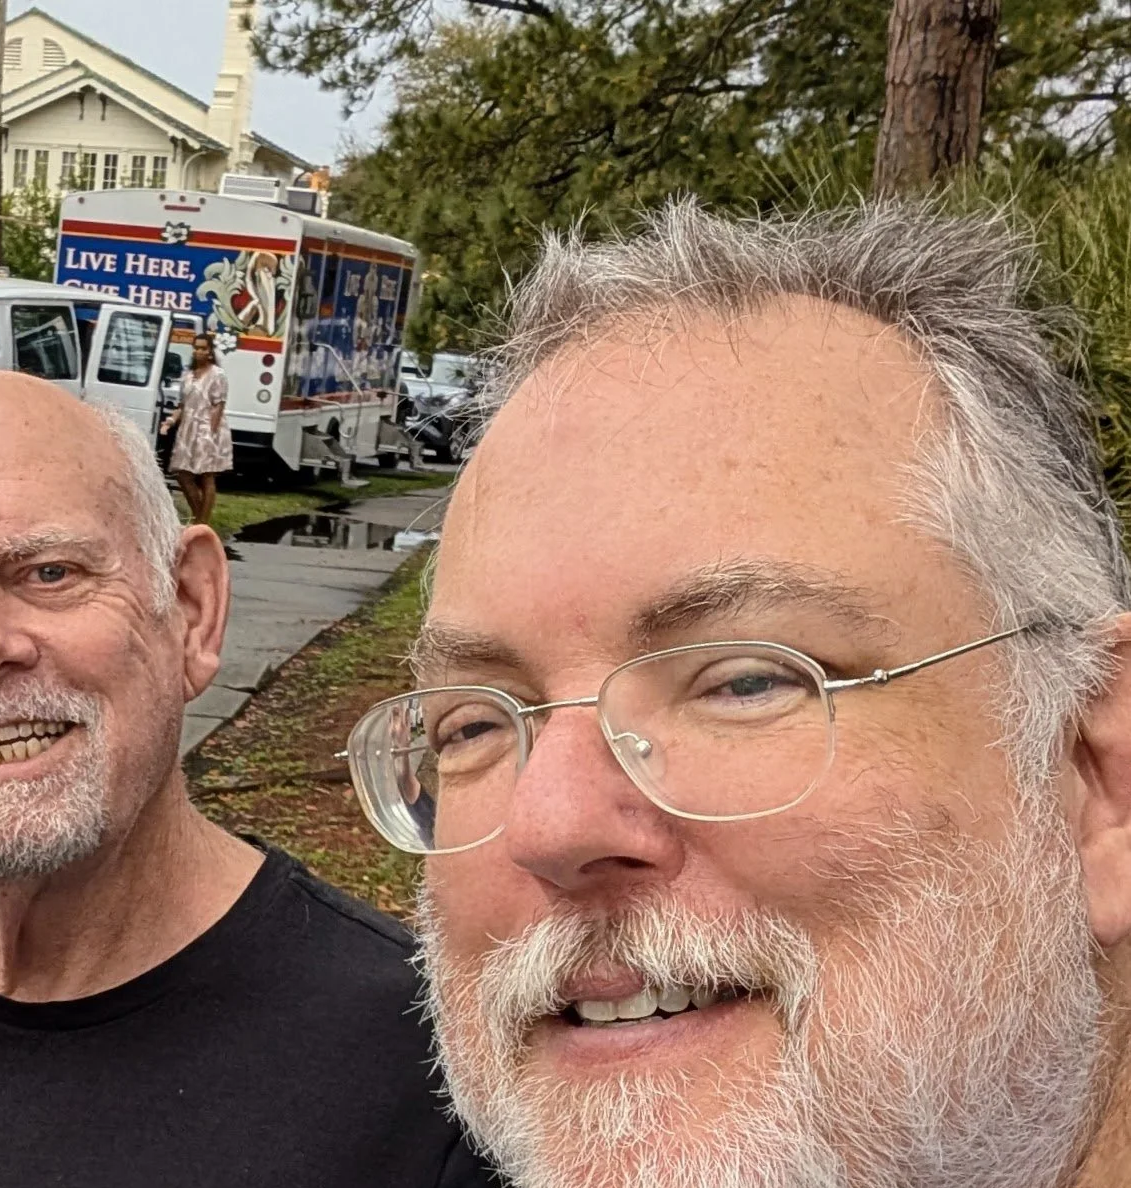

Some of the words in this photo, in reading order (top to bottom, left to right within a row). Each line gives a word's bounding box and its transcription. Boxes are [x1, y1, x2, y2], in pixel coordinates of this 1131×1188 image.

[65, 247, 118, 273] LIVE
[124, 252, 196, 282] HERE,
[128, 284, 193, 310] HERE
